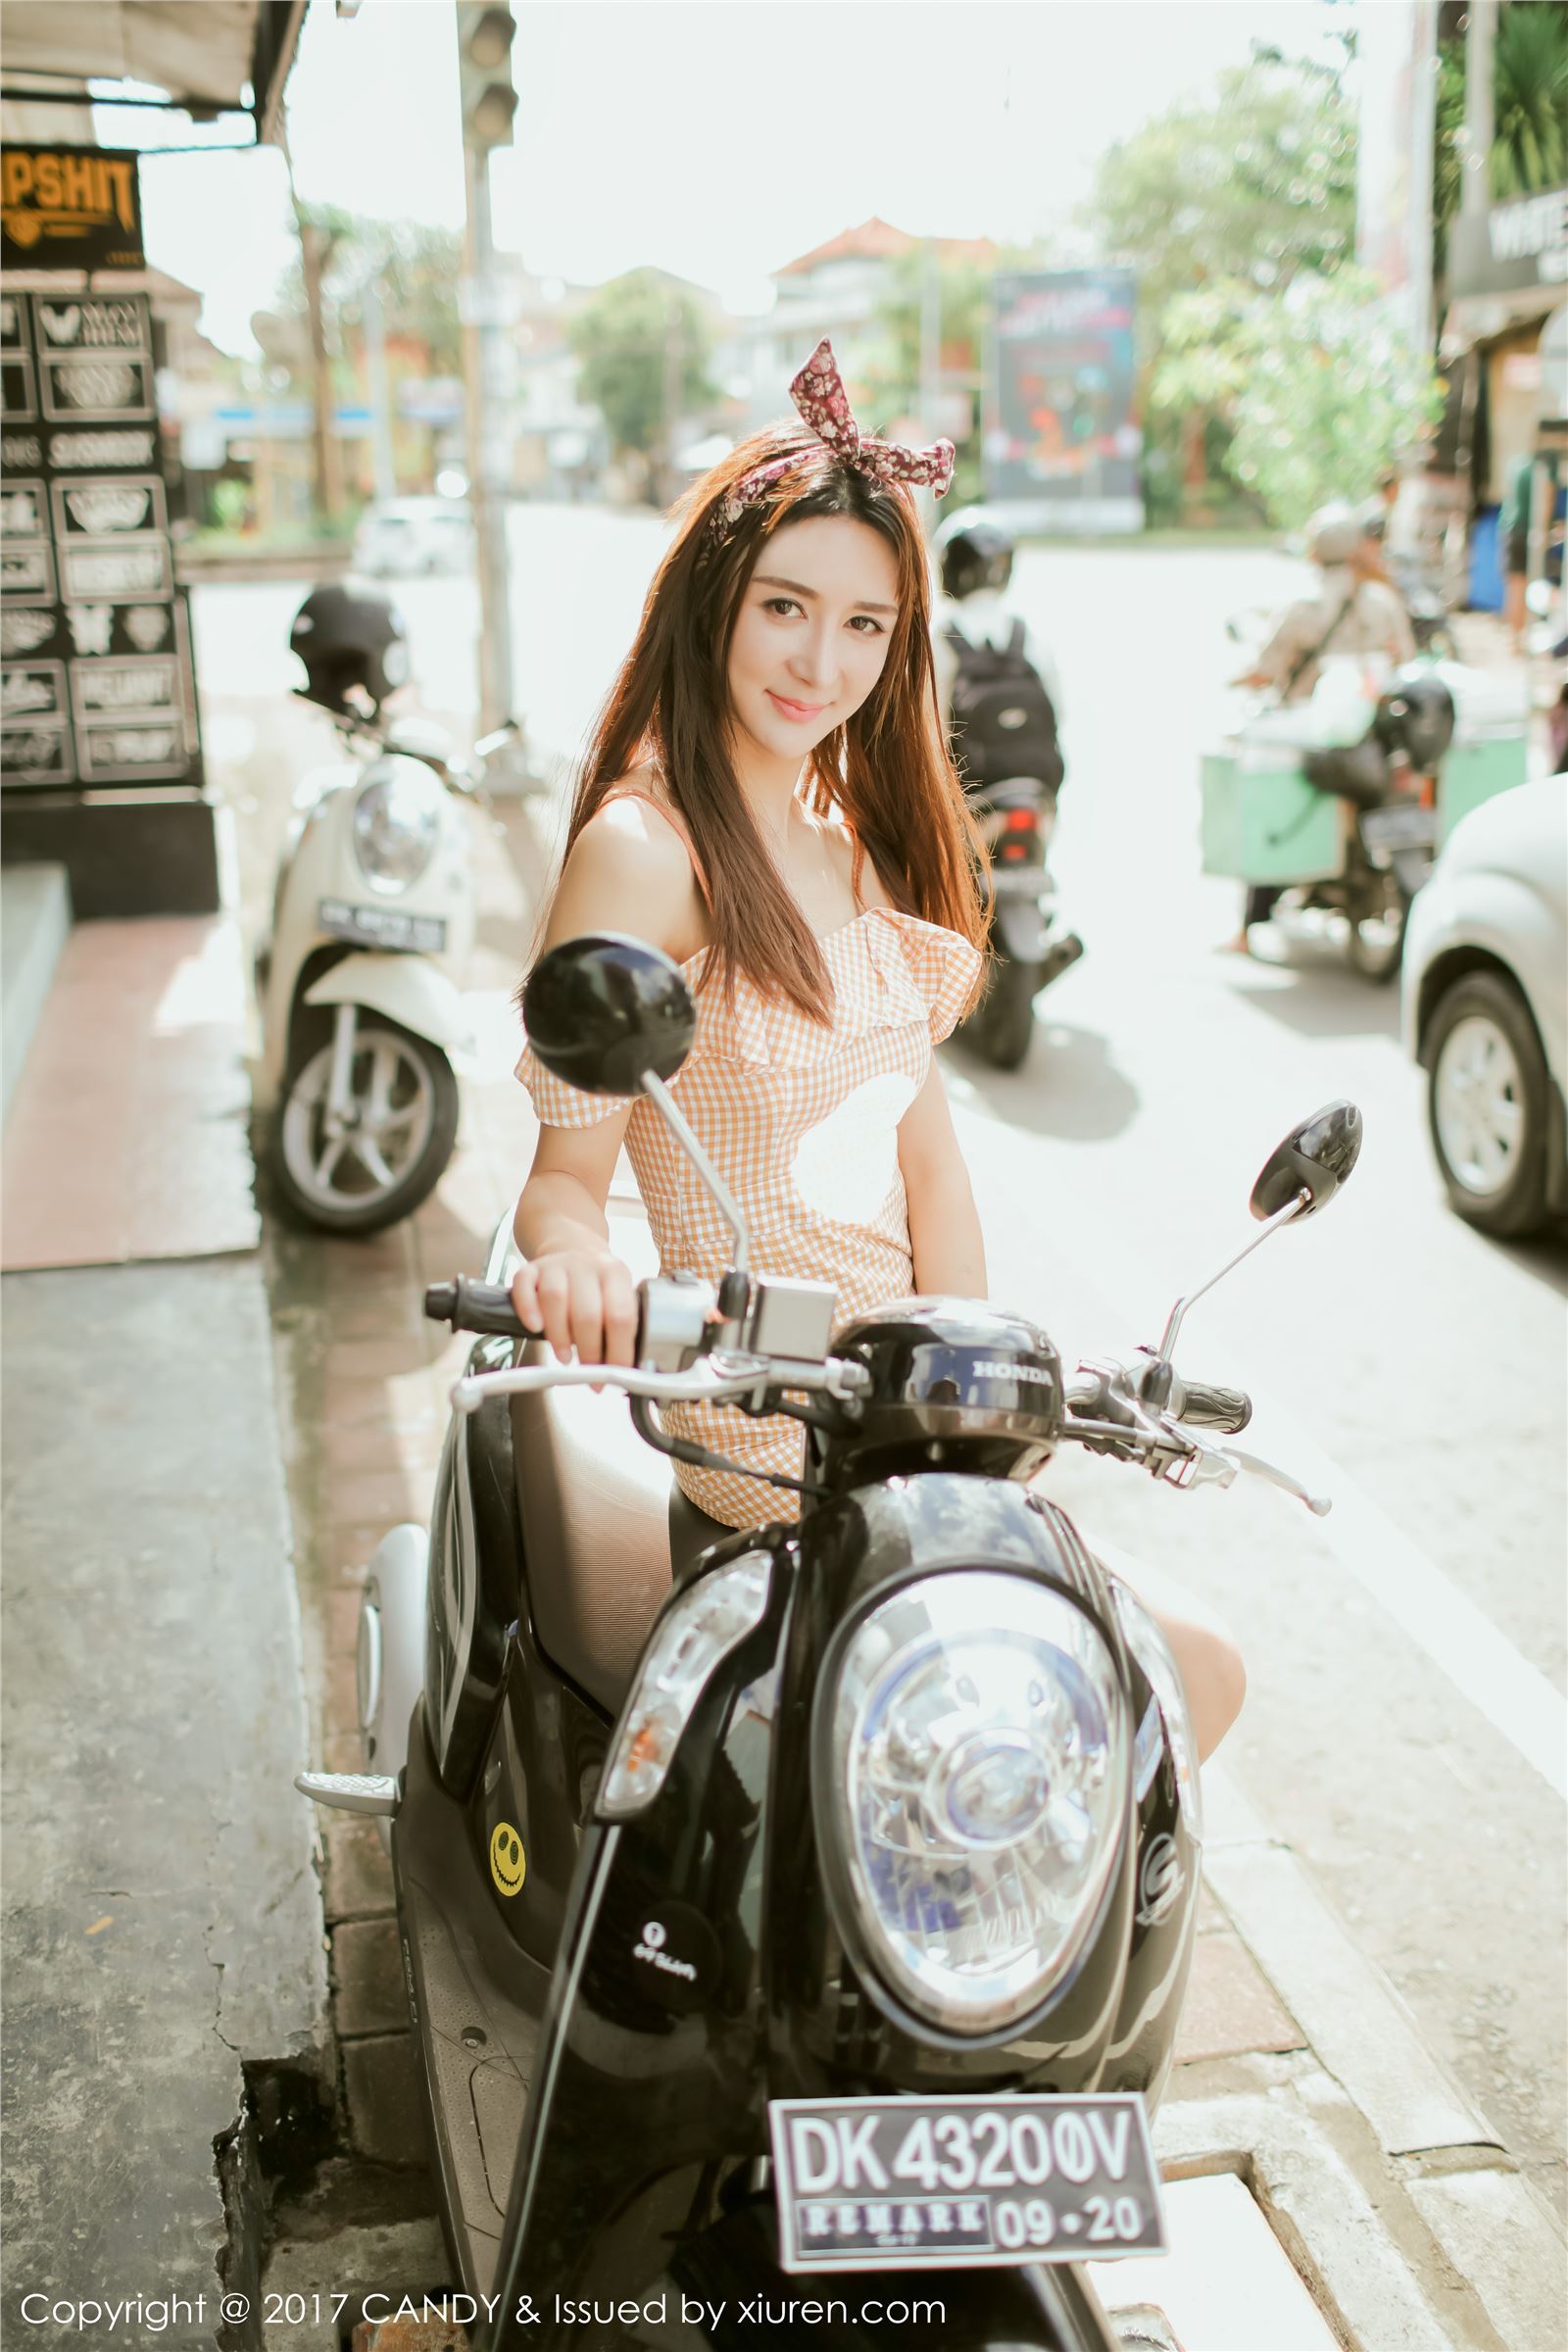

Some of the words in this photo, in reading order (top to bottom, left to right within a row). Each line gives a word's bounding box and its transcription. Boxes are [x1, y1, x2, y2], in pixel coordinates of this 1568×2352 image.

[0, 151, 135, 233] PSHIT
[972, 1360, 1054, 1387] HONDA
[790, 2114, 890, 2193] DK
[806, 2202, 985, 2236] REMARK
